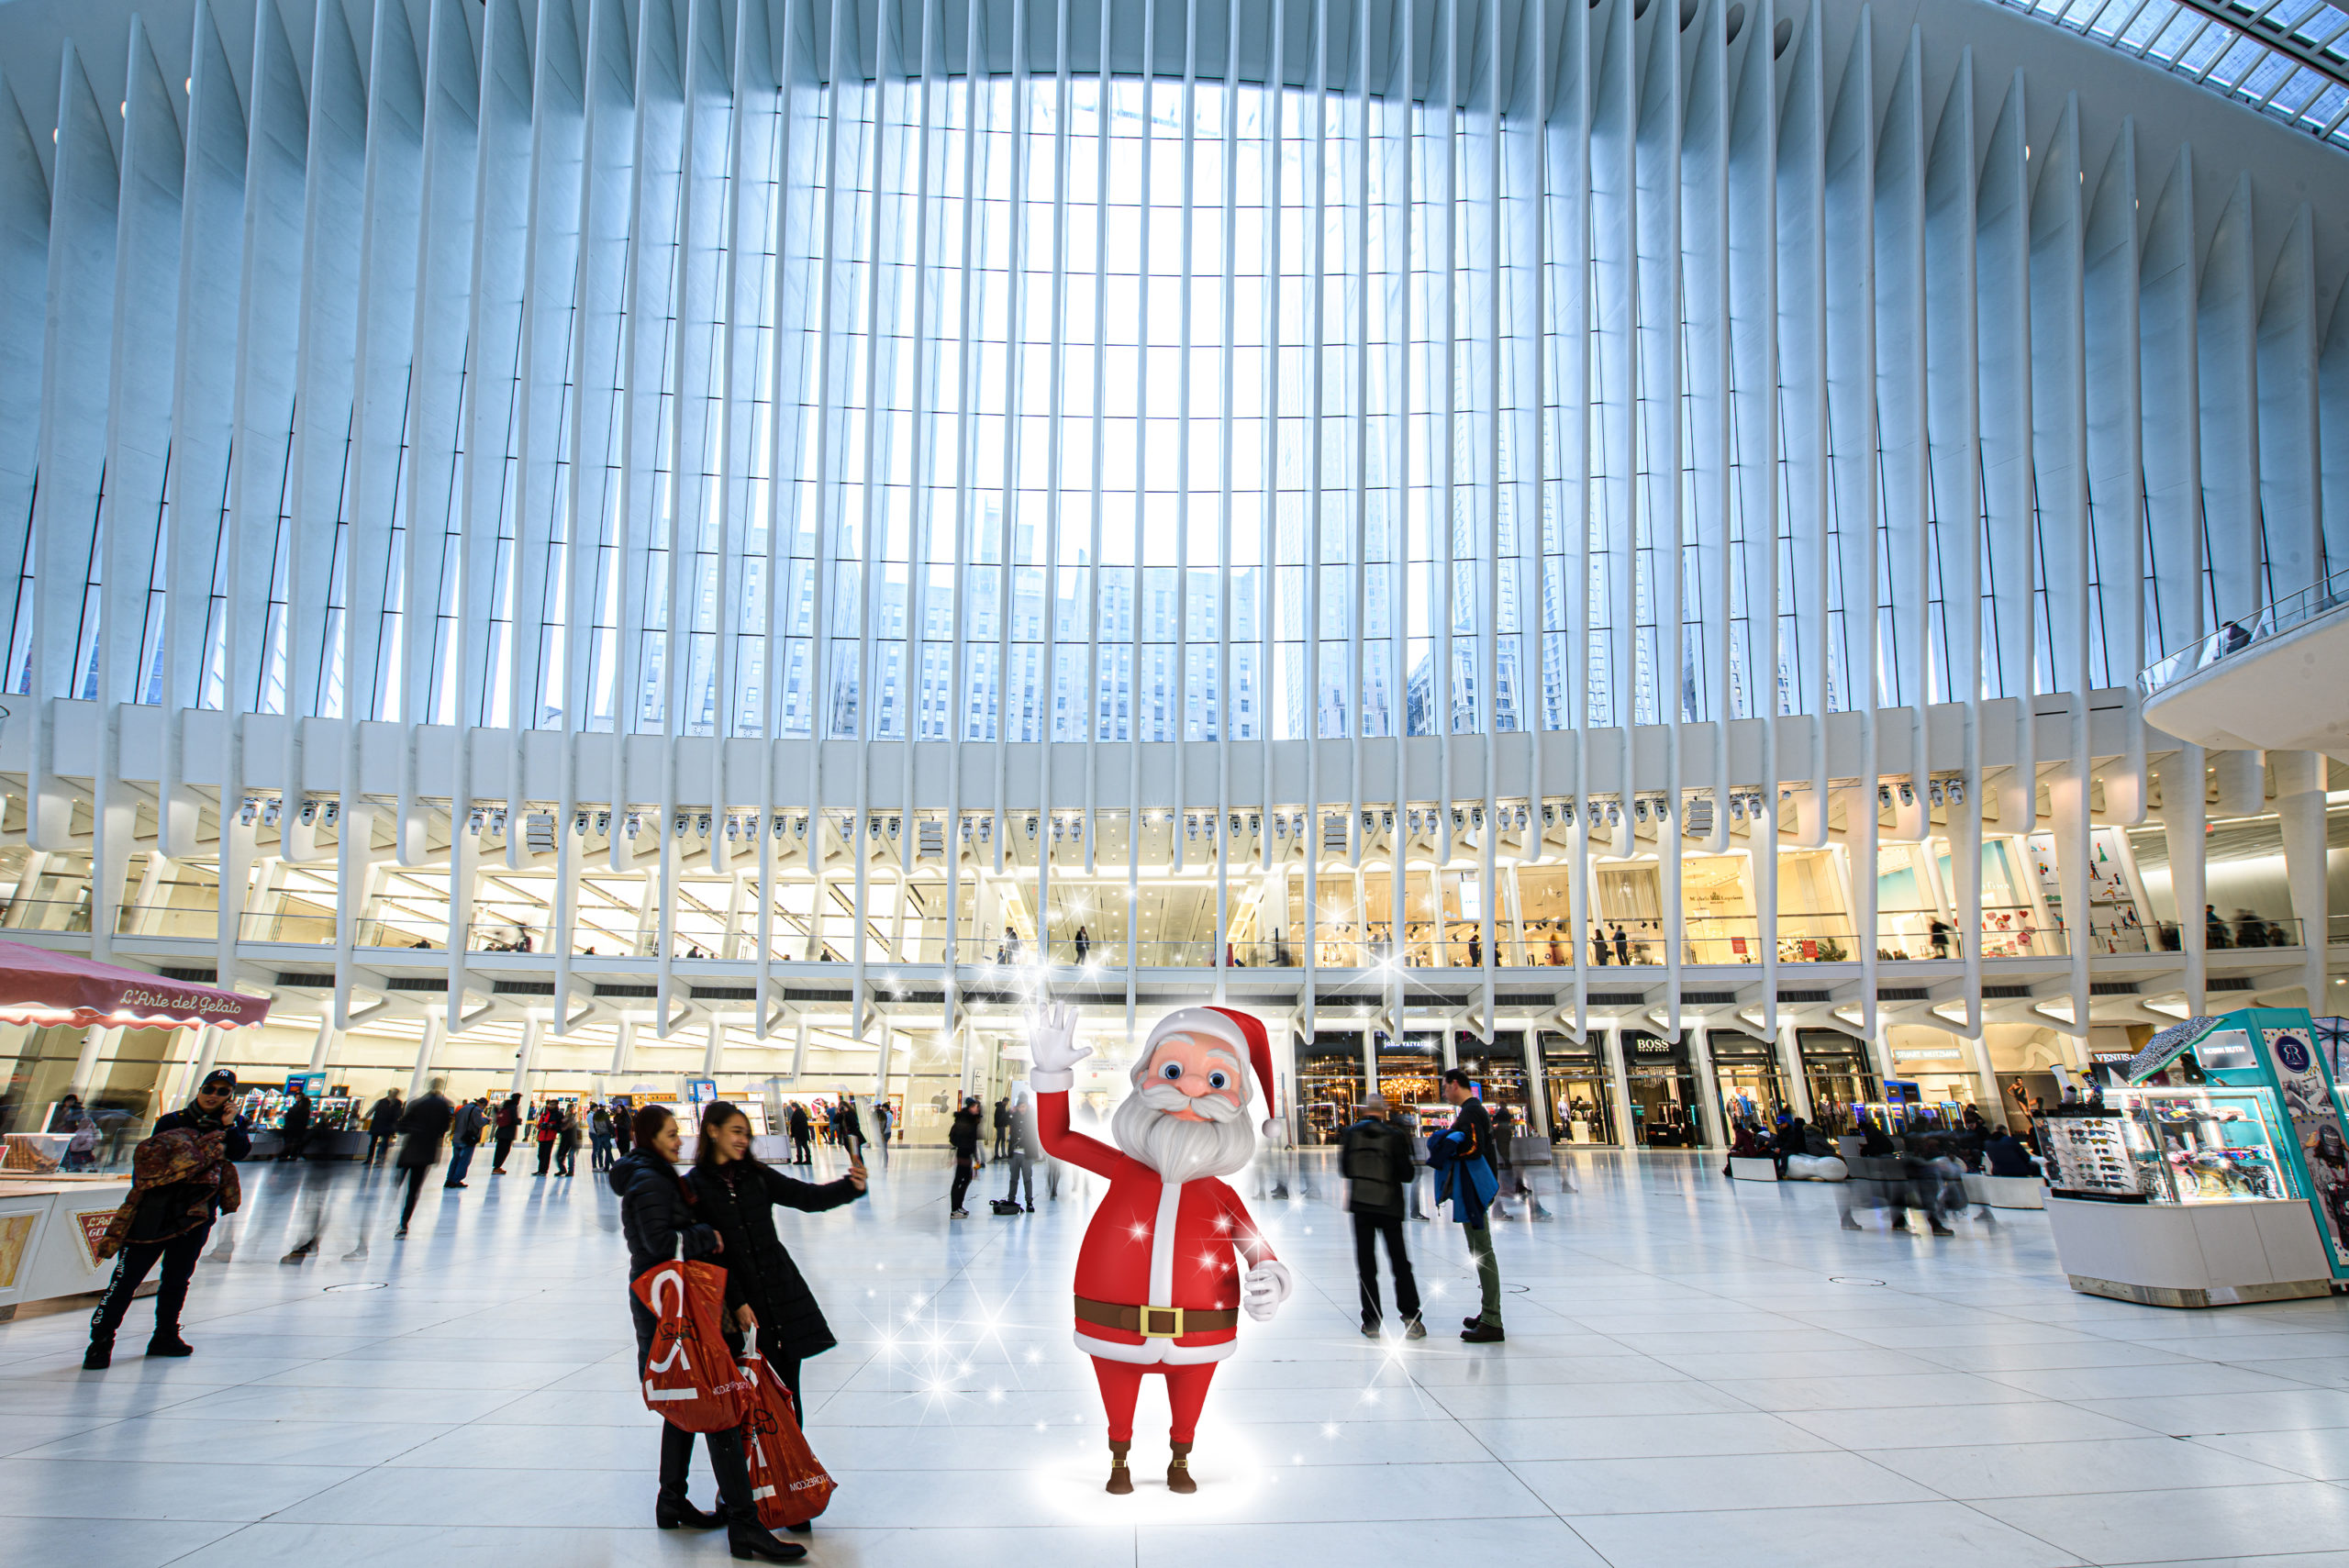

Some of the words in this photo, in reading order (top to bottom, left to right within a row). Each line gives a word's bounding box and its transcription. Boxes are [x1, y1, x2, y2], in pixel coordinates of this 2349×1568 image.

[119, 990, 169, 1007] L'Arte
[172, 995, 197, 1009] del
[199, 997, 241, 1014] Gelato
[1637, 1039, 1669, 1049] BOSS
[2094, 1053, 2131, 1062] VENUS
